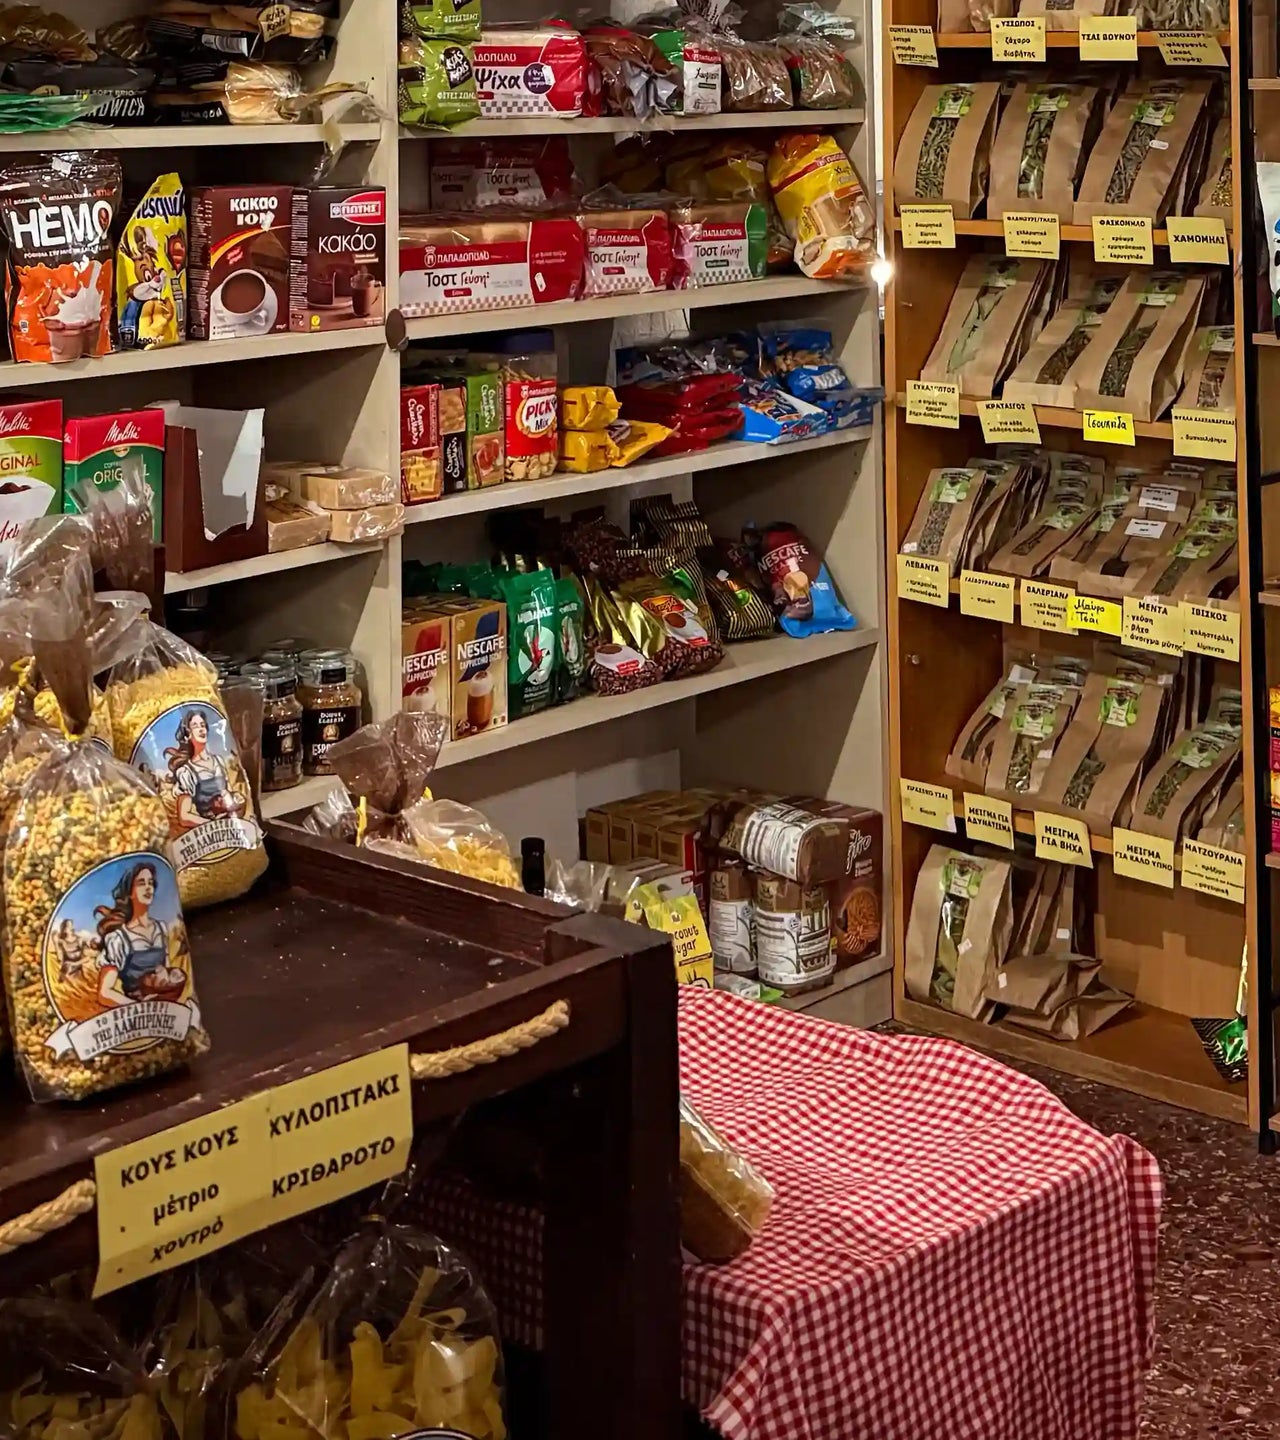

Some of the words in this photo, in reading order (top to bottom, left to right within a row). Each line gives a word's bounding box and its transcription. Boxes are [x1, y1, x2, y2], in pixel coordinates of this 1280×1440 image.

[1102, 34, 1136, 42] ΒΟΥΝΟΥ
[341, 204, 377, 214] ΓΙΩΤΗΣ
[10, 200, 114, 248] HEMO
[318, 227, 376, 253] κακάο
[1173, 234, 1226, 245] ΧΑΜΟΜΗΛΙ
[588, 251, 613, 263] Τοστ
[695, 244, 718, 258] Τοστ
[425, 271, 458, 287] Τοστ
[103, 420, 140, 445] Melitta
[535, 418, 549, 431] Mix
[905, 560, 940, 573] ΛΕΒΑΝΤΑ
[1139, 601, 1168, 616] ΜΕΝΤΑ
[1191, 608, 1227, 622] ΙΒΙΣΚΟΣ
[1131, 614, 1154, 626] γεύση
[406, 669, 437, 683] CAPPUCCINO
[968, 807, 995, 820] ΜΕΙΓΜΑ
[1044, 824, 1080, 843] ΜΕΙΓΜΑ
[1040, 836, 1058, 848] ΓΙΑ
[1059, 840, 1084, 856] ΒΗΧΑ
[1126, 843, 1161, 860] ΜΕΙΓΜΑ
[1184, 842, 1243, 867] ΜΑΤΖΟΥΡΑΝΑ
[1115, 851, 1129, 861] ΓΙΑ
[1130, 854, 1151, 867] ΚΑΛΟ
[1151, 860, 1173, 872] ΥΠΝΟ
[114, 1015, 176, 1037] ΛΑΜΠΡΙΝΗΣ
[269, 1073, 401, 1139] ΧΥΛΟΠΙΤΑΚΙ
[121, 1150, 177, 1188] ΚΟΥΣ
[183, 1126, 239, 1163] ΚΟΥΣ
[272, 1136, 396, 1198] ΚΡΙΘΑΡΟΤΟ
[153, 1183, 220, 1225] μέτριο
[150, 1216, 224, 1264] χοντρό
